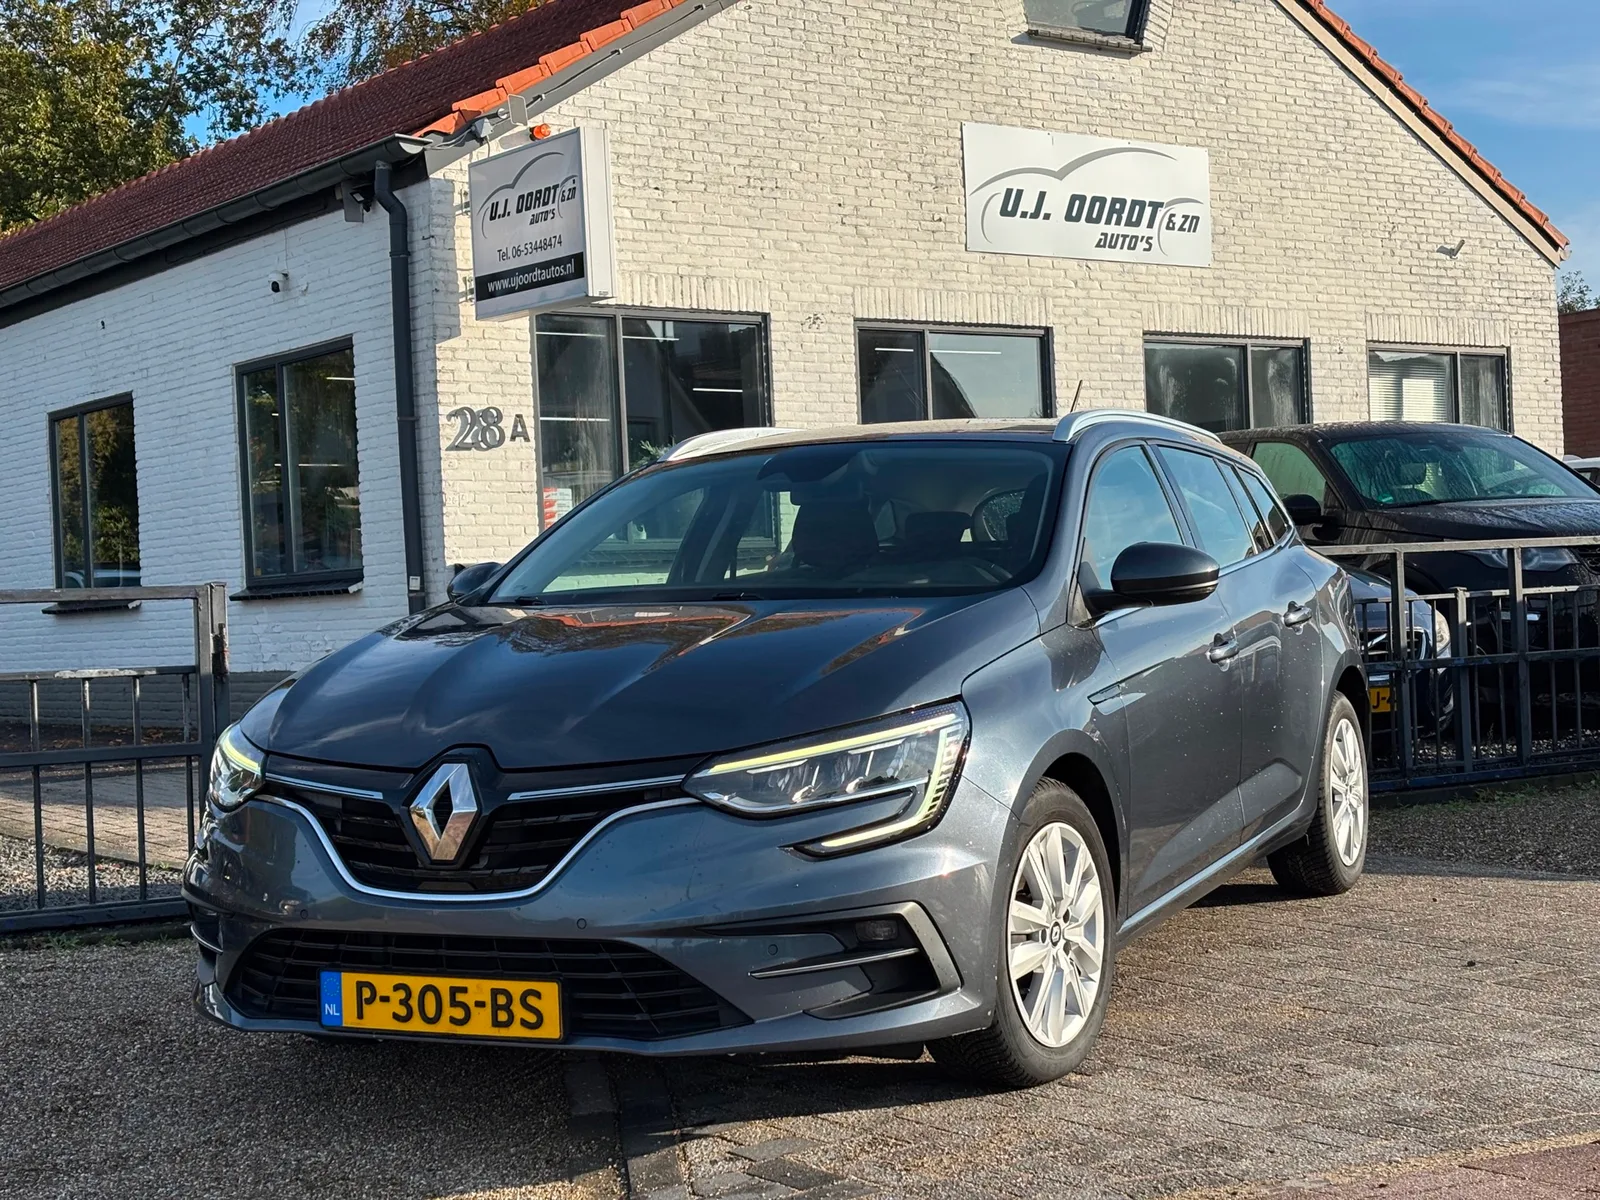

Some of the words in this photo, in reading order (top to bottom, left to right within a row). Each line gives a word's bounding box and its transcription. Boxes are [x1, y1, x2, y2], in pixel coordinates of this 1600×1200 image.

[489, 198, 511, 222] U.J.
[515, 183, 560, 215] OORDT
[560, 190, 566, 203] &
[999, 187, 1051, 221] U.J.
[1064, 193, 1165, 230] OORDT
[1165, 213, 1177, 231] &
[497, 247, 511, 263] Tel.
[511, 234, 563, 259] 06-53448474
[487, 259, 576, 293] www.ujoordtautos.nl
[445, 406, 506, 451] 28
[509, 413, 531, 443] A
[324, 1003, 340, 1017] NL
[355, 980, 545, 1030] P-305-BS
